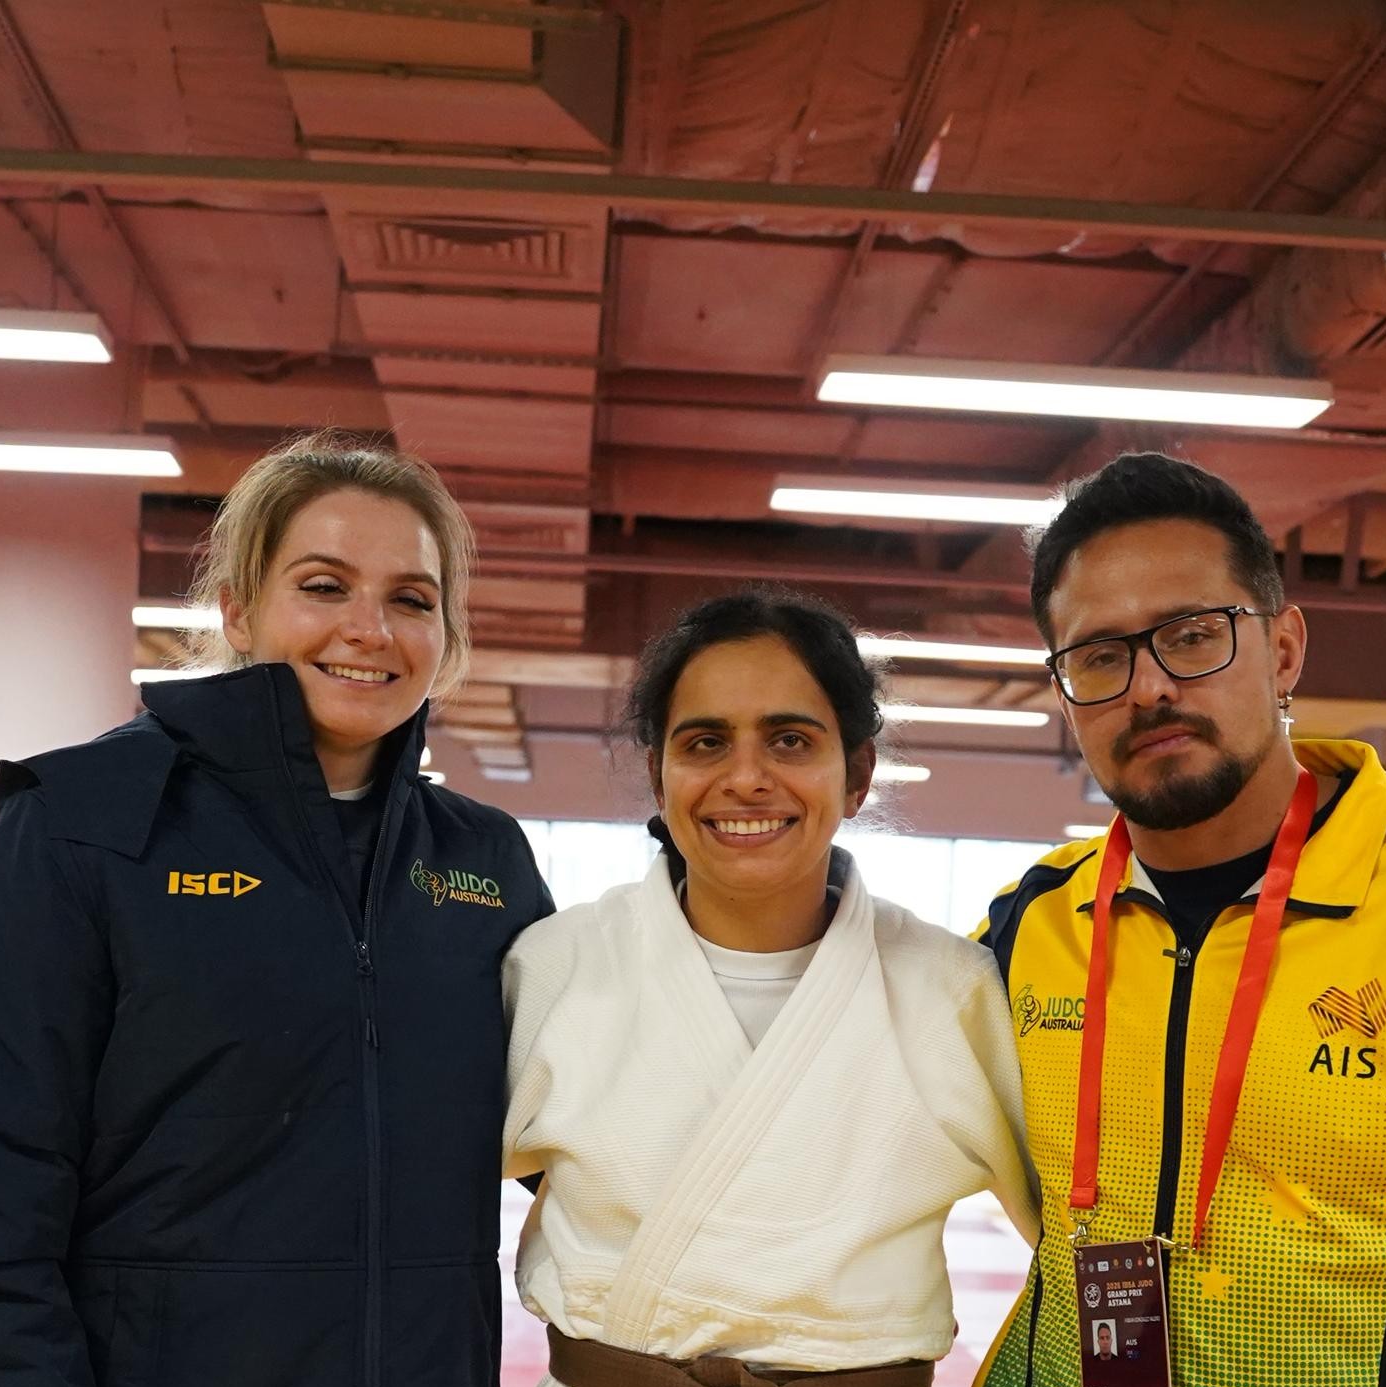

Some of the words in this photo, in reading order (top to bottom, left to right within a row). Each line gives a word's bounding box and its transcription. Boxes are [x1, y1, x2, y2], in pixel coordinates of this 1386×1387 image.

[167, 871, 231, 896] ISC
[447, 869, 501, 897] JUDO
[449, 889, 505, 908] AUSTRALIA
[1308, 1043, 1377, 1079] AIS
[1107, 1290, 1128, 1298] GRAND
[1129, 1289, 1143, 1297] PRIX
[1137, 1280, 1154, 1288] JUDO
[1108, 1298, 1132, 1307] ASTANA
